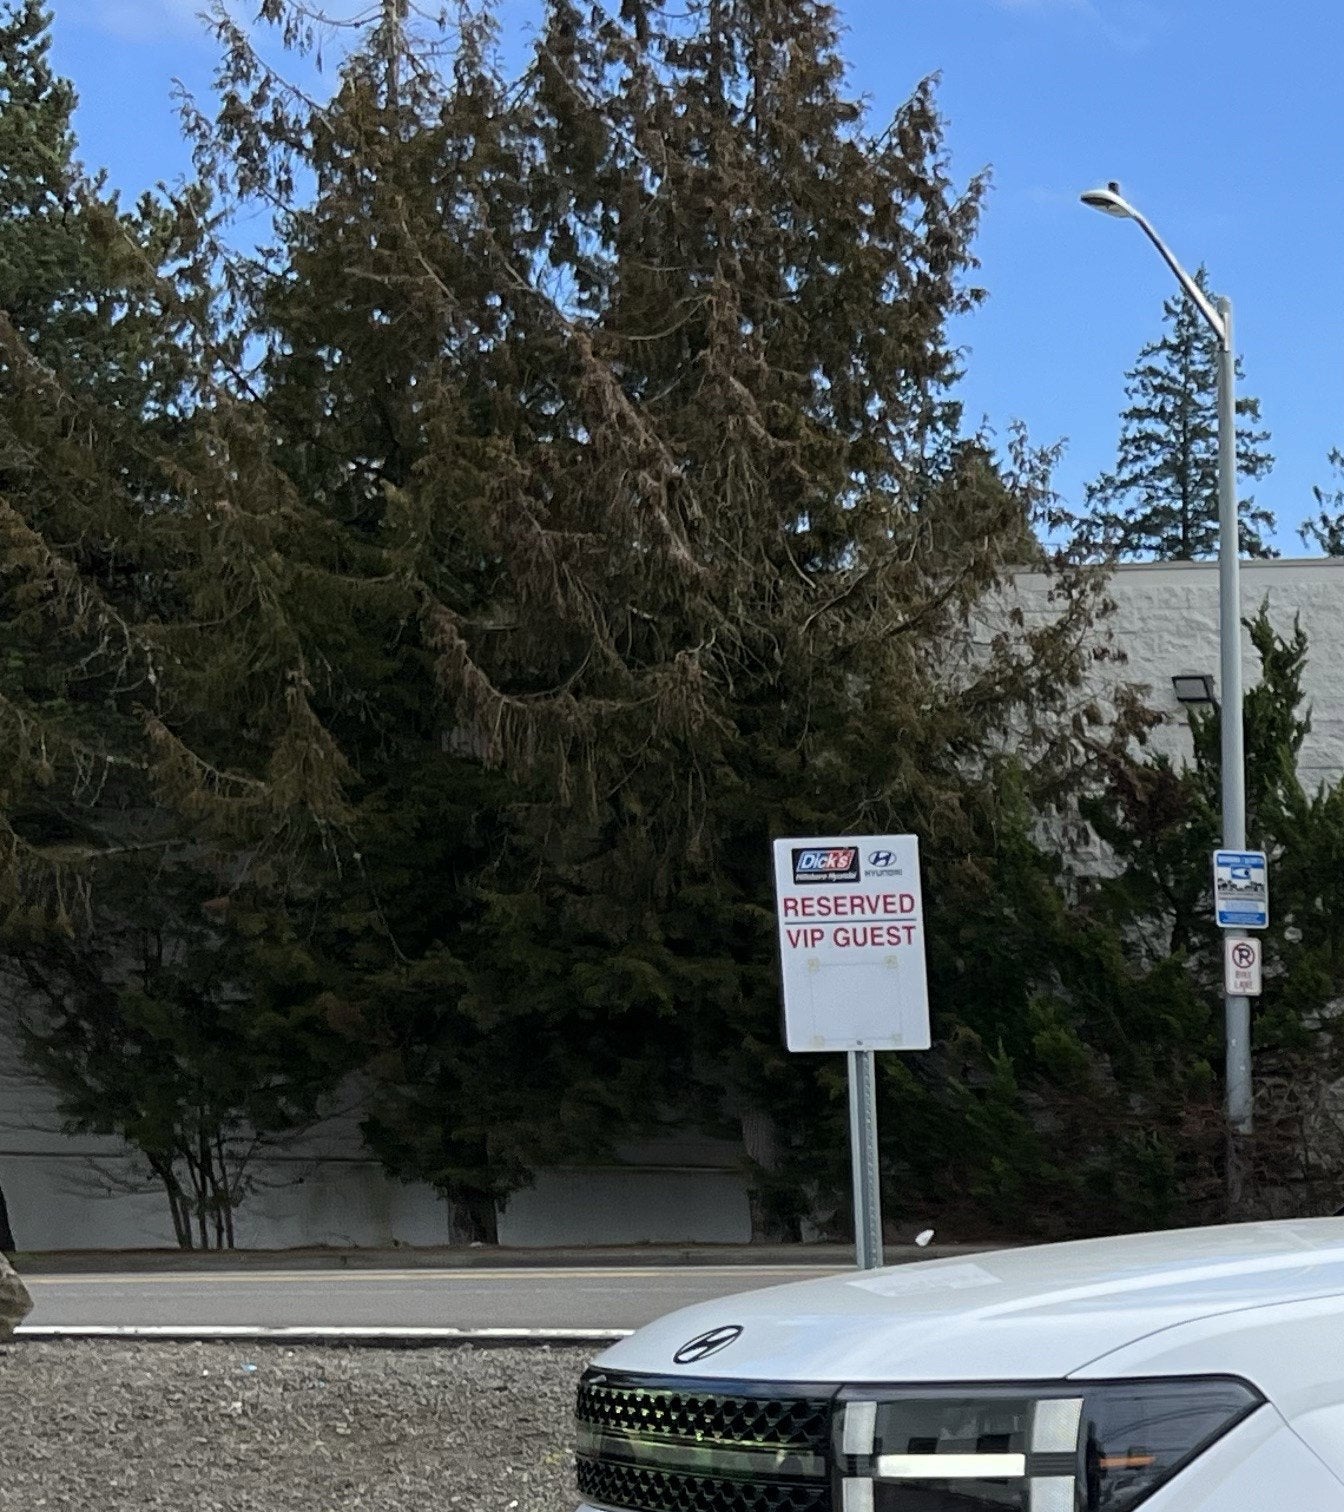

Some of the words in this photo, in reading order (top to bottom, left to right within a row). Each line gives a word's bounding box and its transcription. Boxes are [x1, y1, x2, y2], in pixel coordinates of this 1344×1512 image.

[801, 851, 848, 869] Dick's
[783, 893, 916, 918] RESERVED
[786, 927, 825, 949] VIP
[833, 925, 917, 948] GUEST
